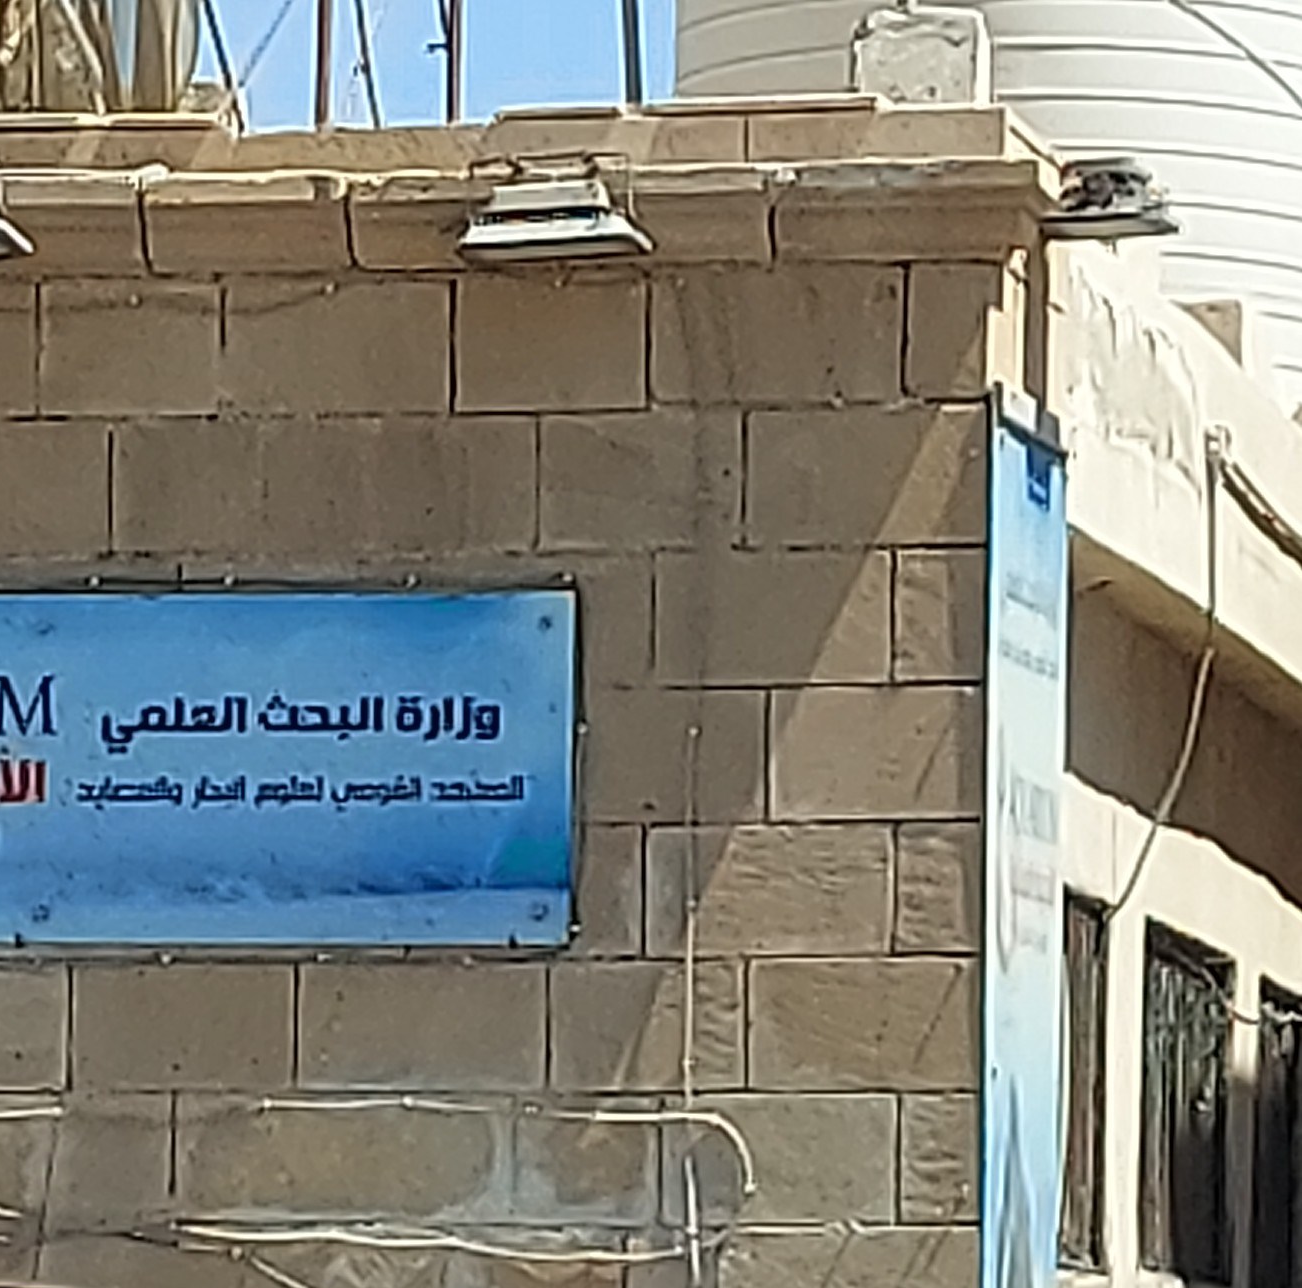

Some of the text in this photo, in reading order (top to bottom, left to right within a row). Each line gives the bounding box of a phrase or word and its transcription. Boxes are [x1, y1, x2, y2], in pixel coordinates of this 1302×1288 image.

[101, 691, 501, 754] وزارة البحث العلمي
